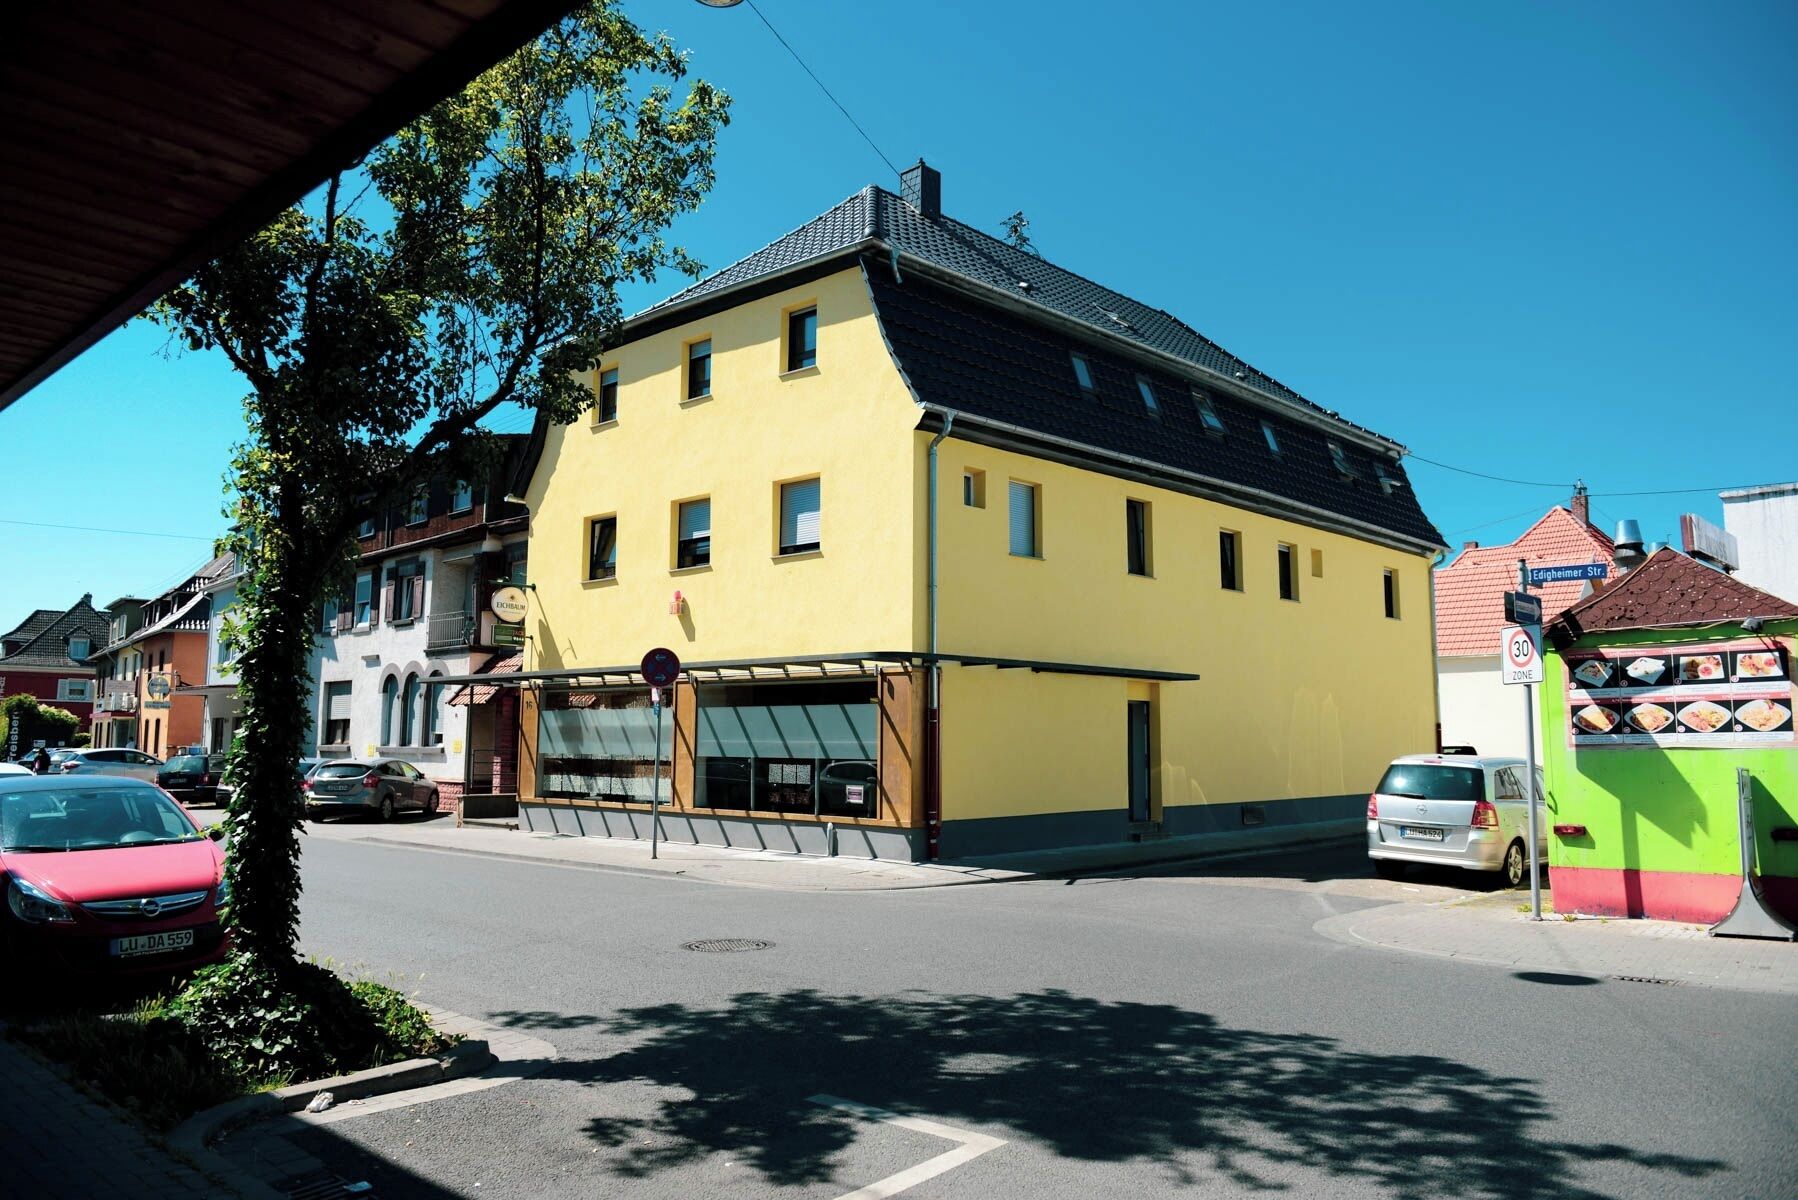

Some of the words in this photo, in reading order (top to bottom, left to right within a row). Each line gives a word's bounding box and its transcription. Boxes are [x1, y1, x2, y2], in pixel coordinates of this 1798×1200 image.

[1533, 568, 1582, 581] Edigheimer
[1587, 566, 1605, 576] Str.
[496, 601, 526, 611] EICHBAUM
[1513, 640, 1529, 658] 30
[1512, 669, 1533, 681] ZONE
[526, 701, 533, 711] 16
[119, 938, 138, 953] LU
[147, 935, 165, 949] DA
[167, 932, 192, 947] 559
